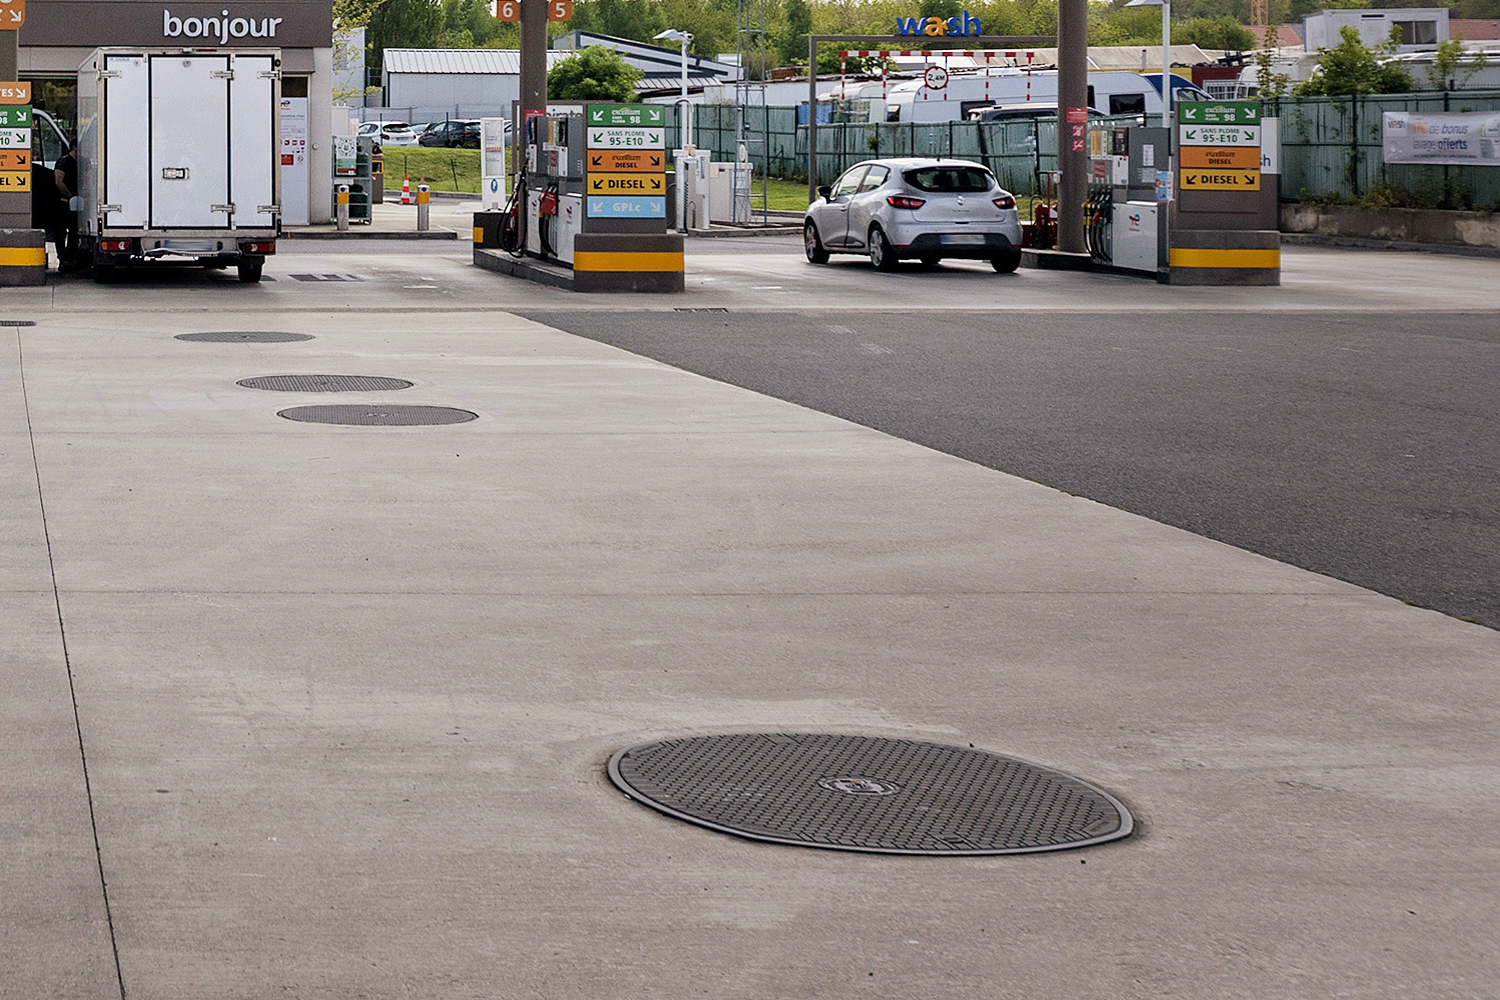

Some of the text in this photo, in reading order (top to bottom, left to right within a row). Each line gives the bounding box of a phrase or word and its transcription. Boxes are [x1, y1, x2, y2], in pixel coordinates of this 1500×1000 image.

[502, 2, 514, 18] 6
[555, 2, 566, 18] 5
[163, 9, 283, 45] bonjour
[895, 10, 982, 36] wash
[630, 116, 641, 124] 98
[1223, 113, 1235, 121] 98
[1441, 123, 1469, 134] bonus
[610, 137, 643, 145] 95-E10
[1202, 134, 1237, 142] 95-E10
[1438, 138, 1468, 149] offerts
[608, 180, 644, 188] DIESEL
[1201, 175, 1238, 184] DIESEL
[613, 203, 641, 212] GPLc
